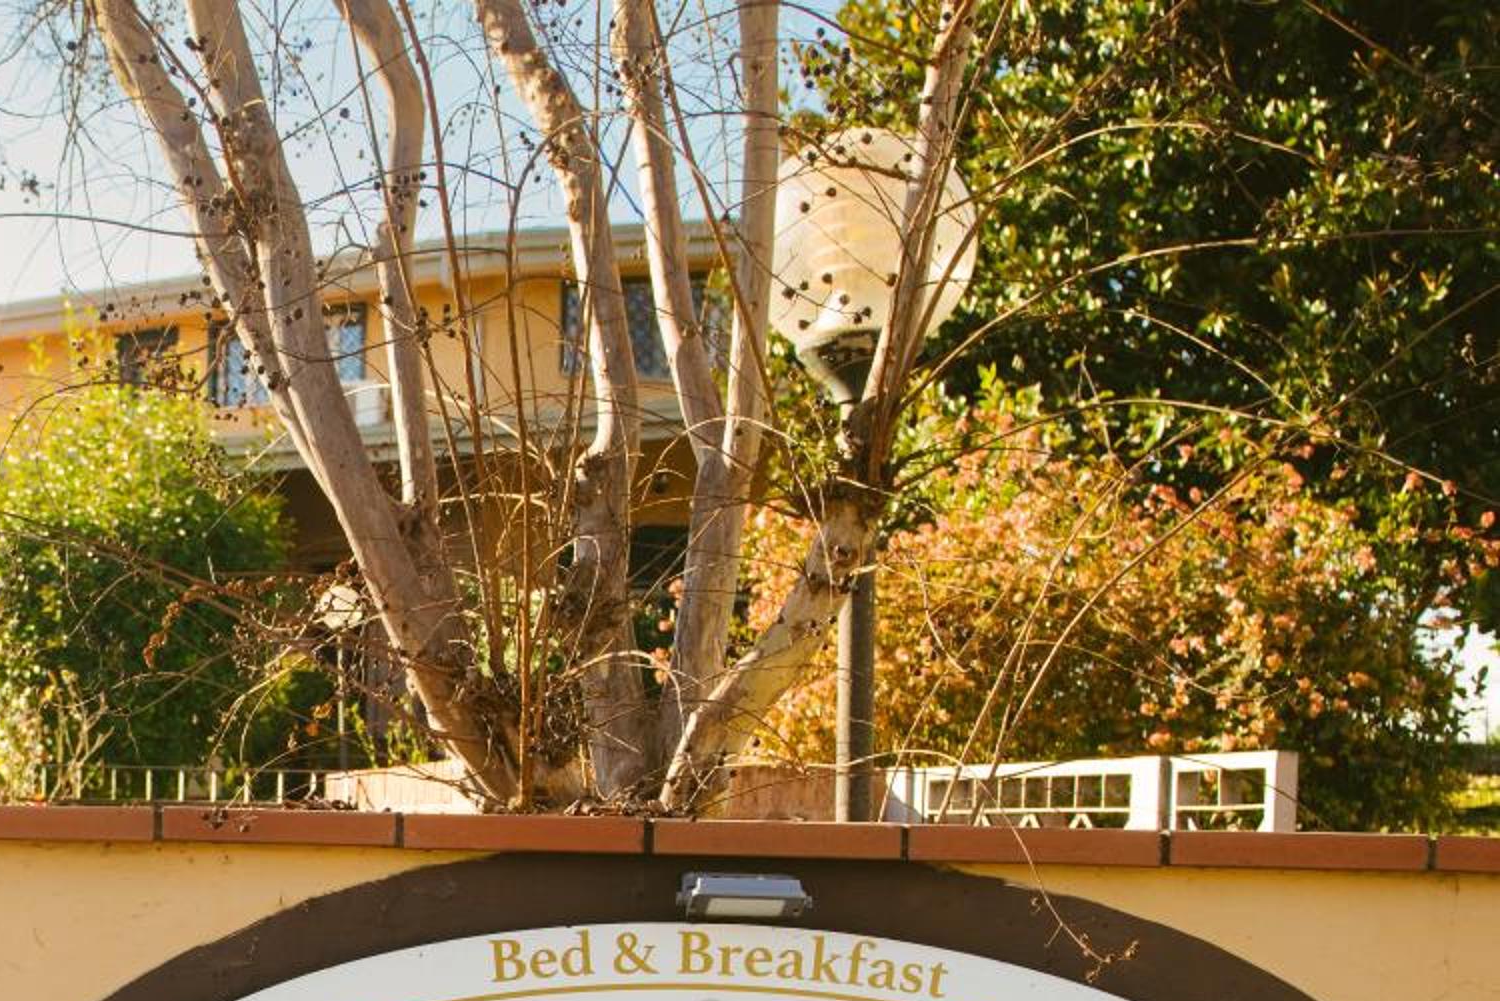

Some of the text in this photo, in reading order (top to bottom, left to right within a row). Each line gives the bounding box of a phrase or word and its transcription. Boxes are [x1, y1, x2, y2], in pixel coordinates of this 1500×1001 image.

[489, 929, 949, 999] Bed & Breakfast
